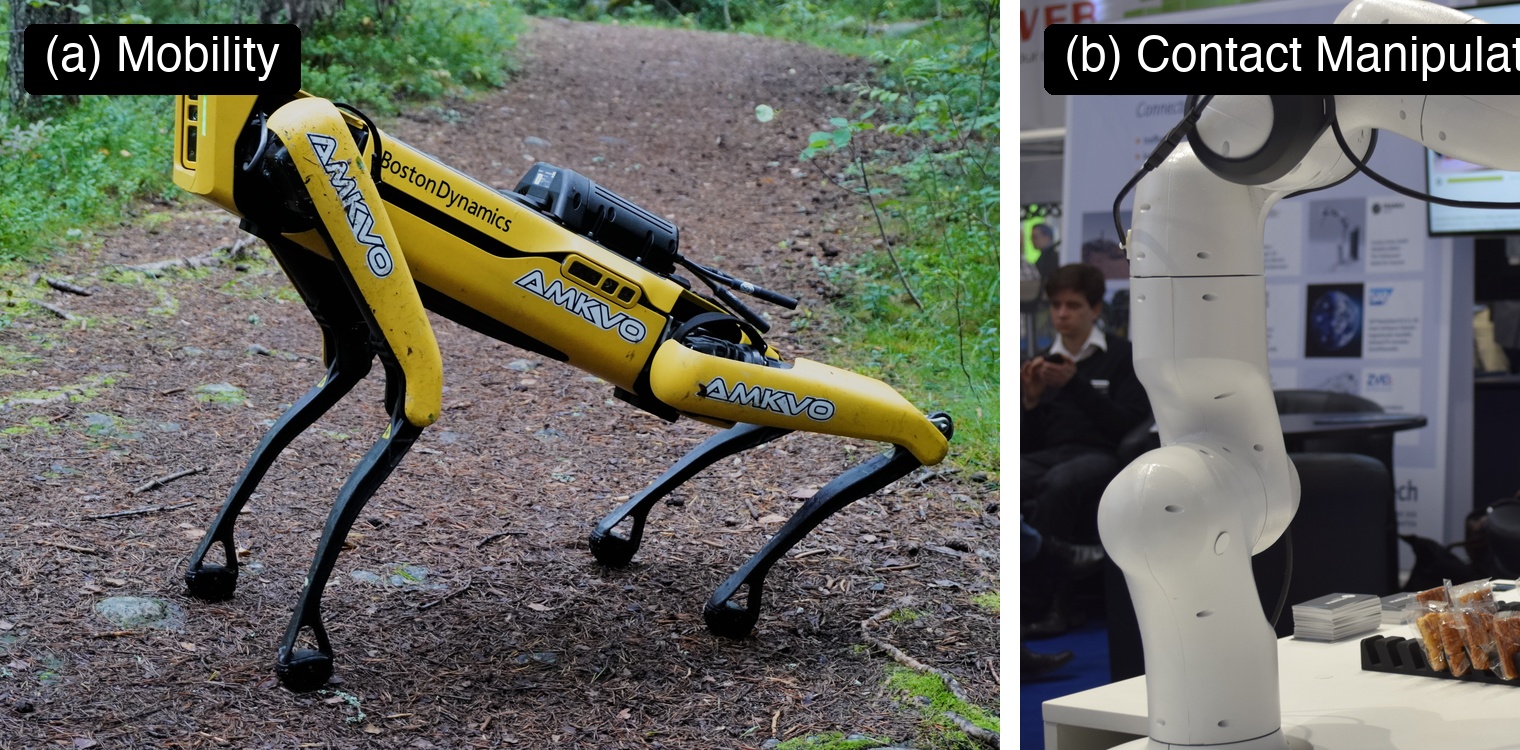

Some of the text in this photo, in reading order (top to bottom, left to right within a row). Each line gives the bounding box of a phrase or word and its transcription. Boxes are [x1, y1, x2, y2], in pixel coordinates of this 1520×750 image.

[306, 132, 394, 279] AMKVO
[512, 268, 648, 344] AMKVO
[695, 376, 836, 422] AMKVO
